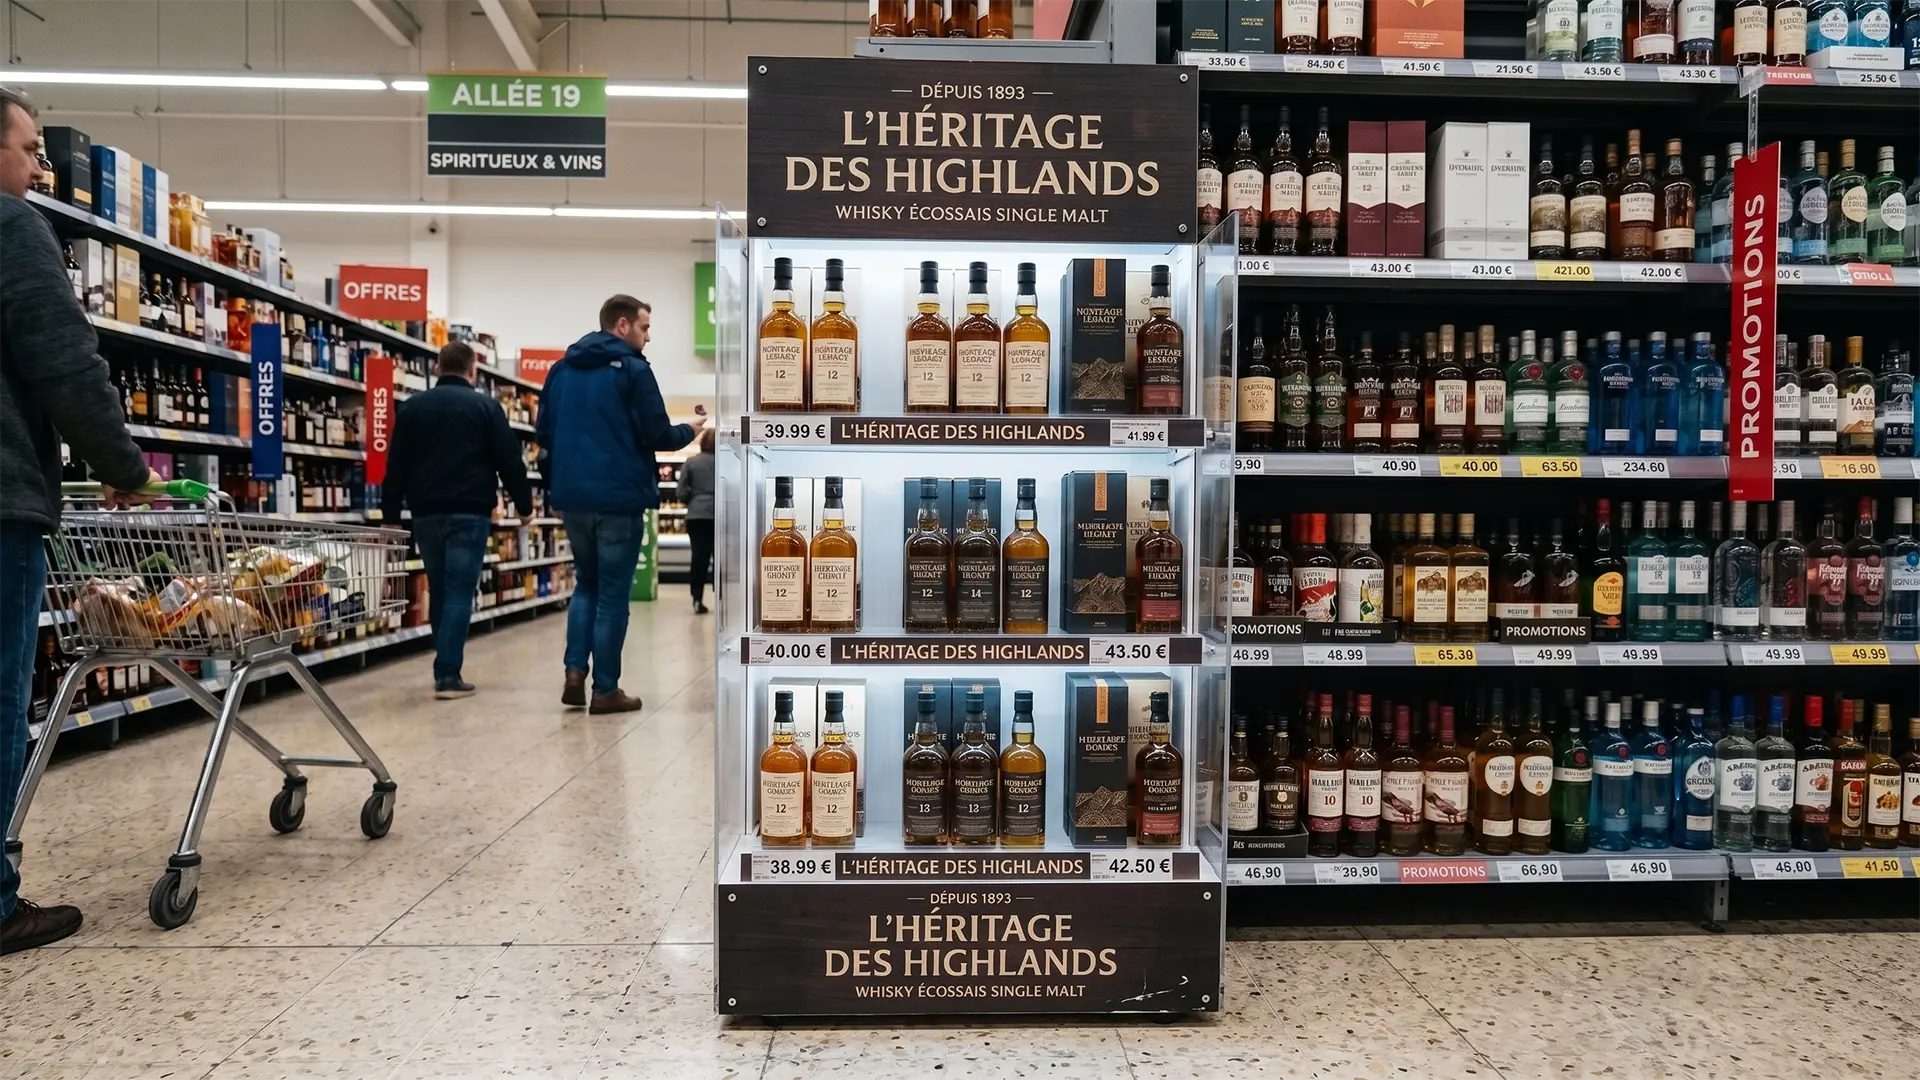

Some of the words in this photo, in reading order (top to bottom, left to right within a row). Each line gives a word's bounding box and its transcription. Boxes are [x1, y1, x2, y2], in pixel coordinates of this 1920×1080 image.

[1239, 58, 1246, 66] €
[1337, 60, 1345, 69] €
[1433, 63, 1440, 71] €
[1496, 65, 1523, 74] 21.50
[1526, 65, 1533, 74] €
[1584, 67, 1612, 76] 43.50
[1614, 67, 1621, 76] €
[1680, 69, 1707, 78] 43.30
[1709, 70, 1716, 78] €
[1860, 74, 1887, 82] 25.50
[1890, 74, 1896, 83] €
[452, 80, 542, 108] ALLÉE
[551, 84, 580, 108] 19
[921, 81, 982, 98] DÉPUIS
[987, 85, 1025, 100] 1893
[842, 103, 1103, 150] L'HÉRITAGE
[430, 153, 538, 169] SPIRITUEUX
[543, 156, 555, 169] &
[560, 155, 602, 170] VINS
[785, 155, 871, 192] DES
[885, 158, 1160, 196] HIGHLANDS
[835, 205, 905, 221] WHISKY
[910, 203, 991, 223] ÉCOSSAIS
[996, 207, 1057, 223] SINGLE
[1061, 209, 1109, 224] MALT
[1262, 261, 1269, 270] €
[1371, 263, 1401, 273] 43.00
[1404, 264, 1412, 273] €
[1505, 266, 1512, 275] €
[1554, 266, 1589, 276] 421.00
[1641, 268, 1670, 277] 42.00
[1674, 268, 1681, 277] €
[1793, 271, 1800, 279] €
[344, 282, 421, 302] OFFRES
[1741, 194, 1765, 459] PROMOTIONS
[775, 370, 786, 379] 12
[828, 370, 838, 380] 12
[922, 372, 934, 381] 12
[971, 372, 983, 382] 12
[1020, 372, 1031, 382] 12
[258, 361, 274, 435] OFFRES
[373, 387, 387, 452] OFFRES
[765, 423, 810, 439] 39.99
[815, 424, 825, 438] €
[842, 421, 940, 439] L'HÉRITAGE
[945, 424, 977, 439] DES
[982, 424, 1085, 440] HIGHLANDS
[1128, 432, 1155, 442] 41.99
[1157, 432, 1165, 441] €
[1382, 461, 1416, 471] 40.90
[1462, 461, 1497, 472] 40.00
[1542, 462, 1577, 472] 63.50
[1623, 462, 1665, 472] 234.60
[1841, 463, 1876, 474] 16.90
[776, 588, 787, 598] 12
[826, 589, 838, 598] 12
[921, 588, 933, 598] 12
[971, 589, 982, 598] 14
[1020, 589, 1032, 598] 12
[1231, 624, 1301, 635] ROMOTIONS
[1506, 626, 1586, 636] PROMOTIONS
[765, 643, 811, 659] 40.00
[815, 644, 826, 658] €
[842, 641, 940, 659] L'HÉRITAGE
[944, 644, 977, 659] DES
[982, 644, 1084, 659] HIGHLANDS
[1105, 644, 1151, 659] 43.50
[1156, 644, 1167, 659] €
[1234, 650, 1269, 660] 46.99
[1328, 650, 1362, 660] 48.99
[1537, 649, 1572, 660] 49.99
[1623, 649, 1658, 660] 49.99
[1766, 649, 1800, 659] 49.99
[1852, 649, 1886, 659] 49.99
[1324, 795, 1336, 805] 10
[1361, 795, 1373, 805] 10
[776, 804, 786, 814] 12
[826, 804, 838, 814] 12
[1018, 804, 1029, 813] 12
[770, 859, 817, 875] 38.99
[821, 859, 832, 874] €
[842, 856, 940, 875] L'HÉRITAGE
[944, 860, 977, 875] DES
[982, 859, 1083, 874] HIGHLANDS
[1109, 858, 1155, 874] 42.50
[1159, 858, 1170, 873] €
[1521, 864, 1558, 876] 66,90
[1630, 862, 1667, 875] 46,90
[1245, 866, 1282, 879] 46,90
[1403, 866, 1485, 878] PROMOTIONS
[930, 890, 979, 905] DÉPUIS
[981, 892, 1012, 905] 1893
[868, 909, 1072, 943] L'HÉRITAGE
[825, 949, 892, 978] DES
[903, 949, 1117, 978] HIGHLANDS
[855, 985, 914, 998] WHISKY
[918, 983, 987, 998] ÉCOSSAIS
[991, 985, 1043, 998] SINGLE
[1046, 985, 1085, 998] MALT
